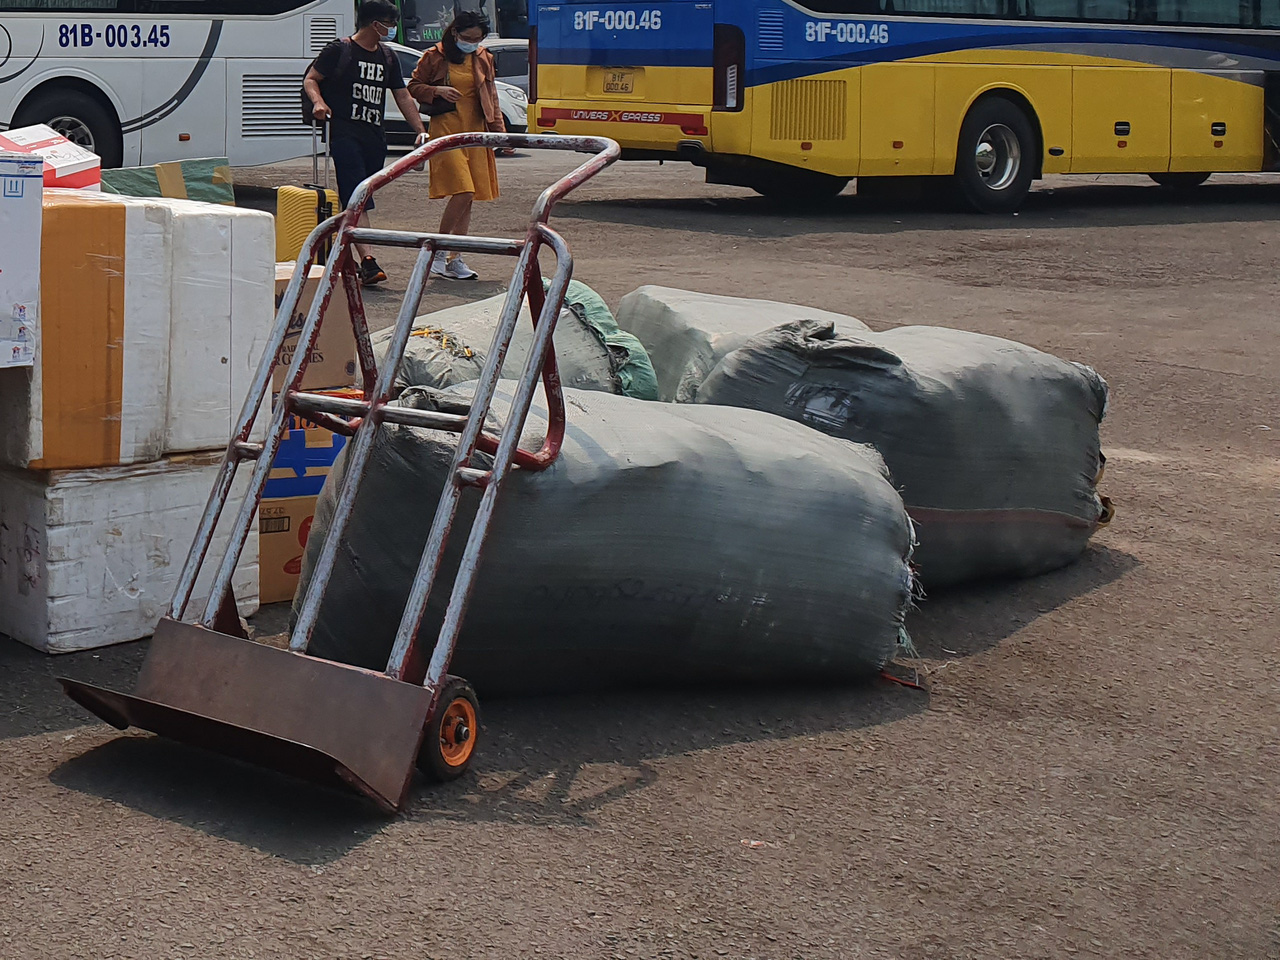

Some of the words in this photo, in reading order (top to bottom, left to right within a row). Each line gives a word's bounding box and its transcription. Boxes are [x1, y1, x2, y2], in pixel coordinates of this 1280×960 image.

[574, 10, 662, 31] 81F-000.46
[805, 21, 889, 44] 81F-000.46
[358, 61, 384, 82] THE
[352, 82, 383, 105] GOOD
[351, 103, 381, 126] LIFE
